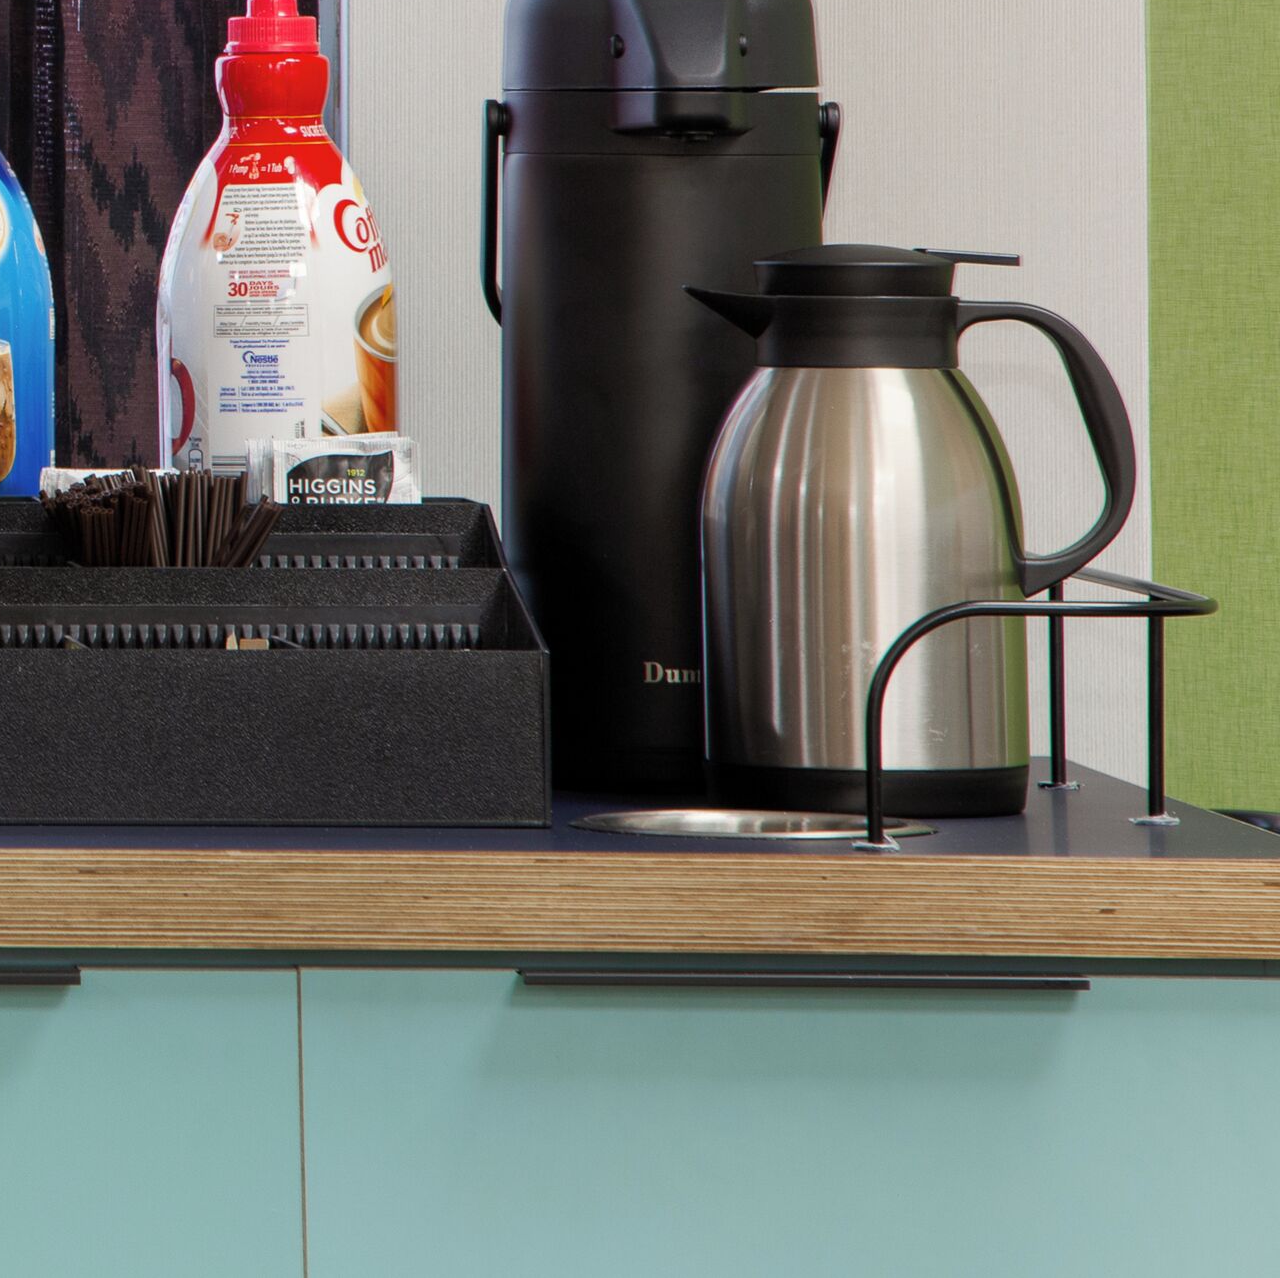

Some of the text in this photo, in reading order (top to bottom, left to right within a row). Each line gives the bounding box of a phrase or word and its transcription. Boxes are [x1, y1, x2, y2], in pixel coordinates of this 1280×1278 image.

[228, 282, 248, 297] 30
[346, 468, 366, 477] 1912
[289, 478, 377, 494] HIGGINS
